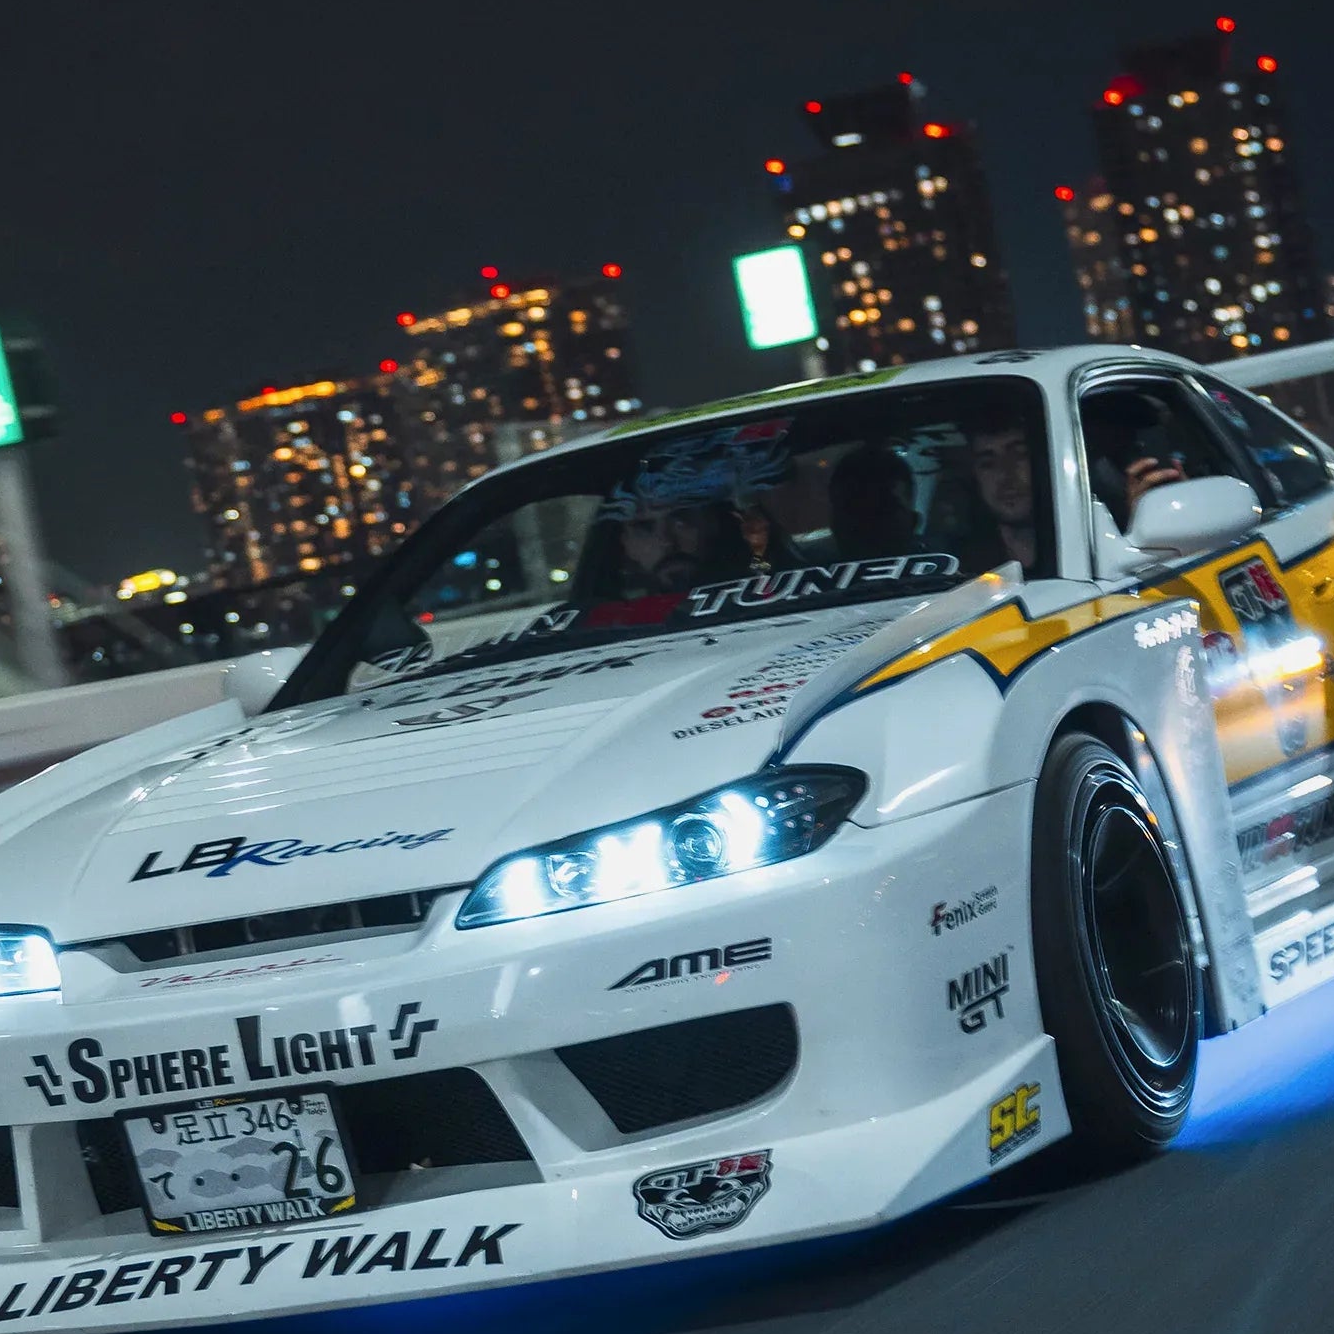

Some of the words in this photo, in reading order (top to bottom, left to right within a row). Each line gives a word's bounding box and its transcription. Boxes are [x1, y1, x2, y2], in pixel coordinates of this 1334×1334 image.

[931, 901, 978, 936] Fenix
[607, 937, 772, 991] AME
[946, 953, 1010, 1011] MINI
[960, 985, 1010, 1034] GT
[173, 1112, 236, 1146] 足立
[236, 1101, 294, 1136] 346
[271, 1136, 346, 1200] 26
[185, 1204, 266, 1233] LIBERTY
[265, 1197, 326, 1225] WALK
[301, 1223, 524, 1279] WALK
